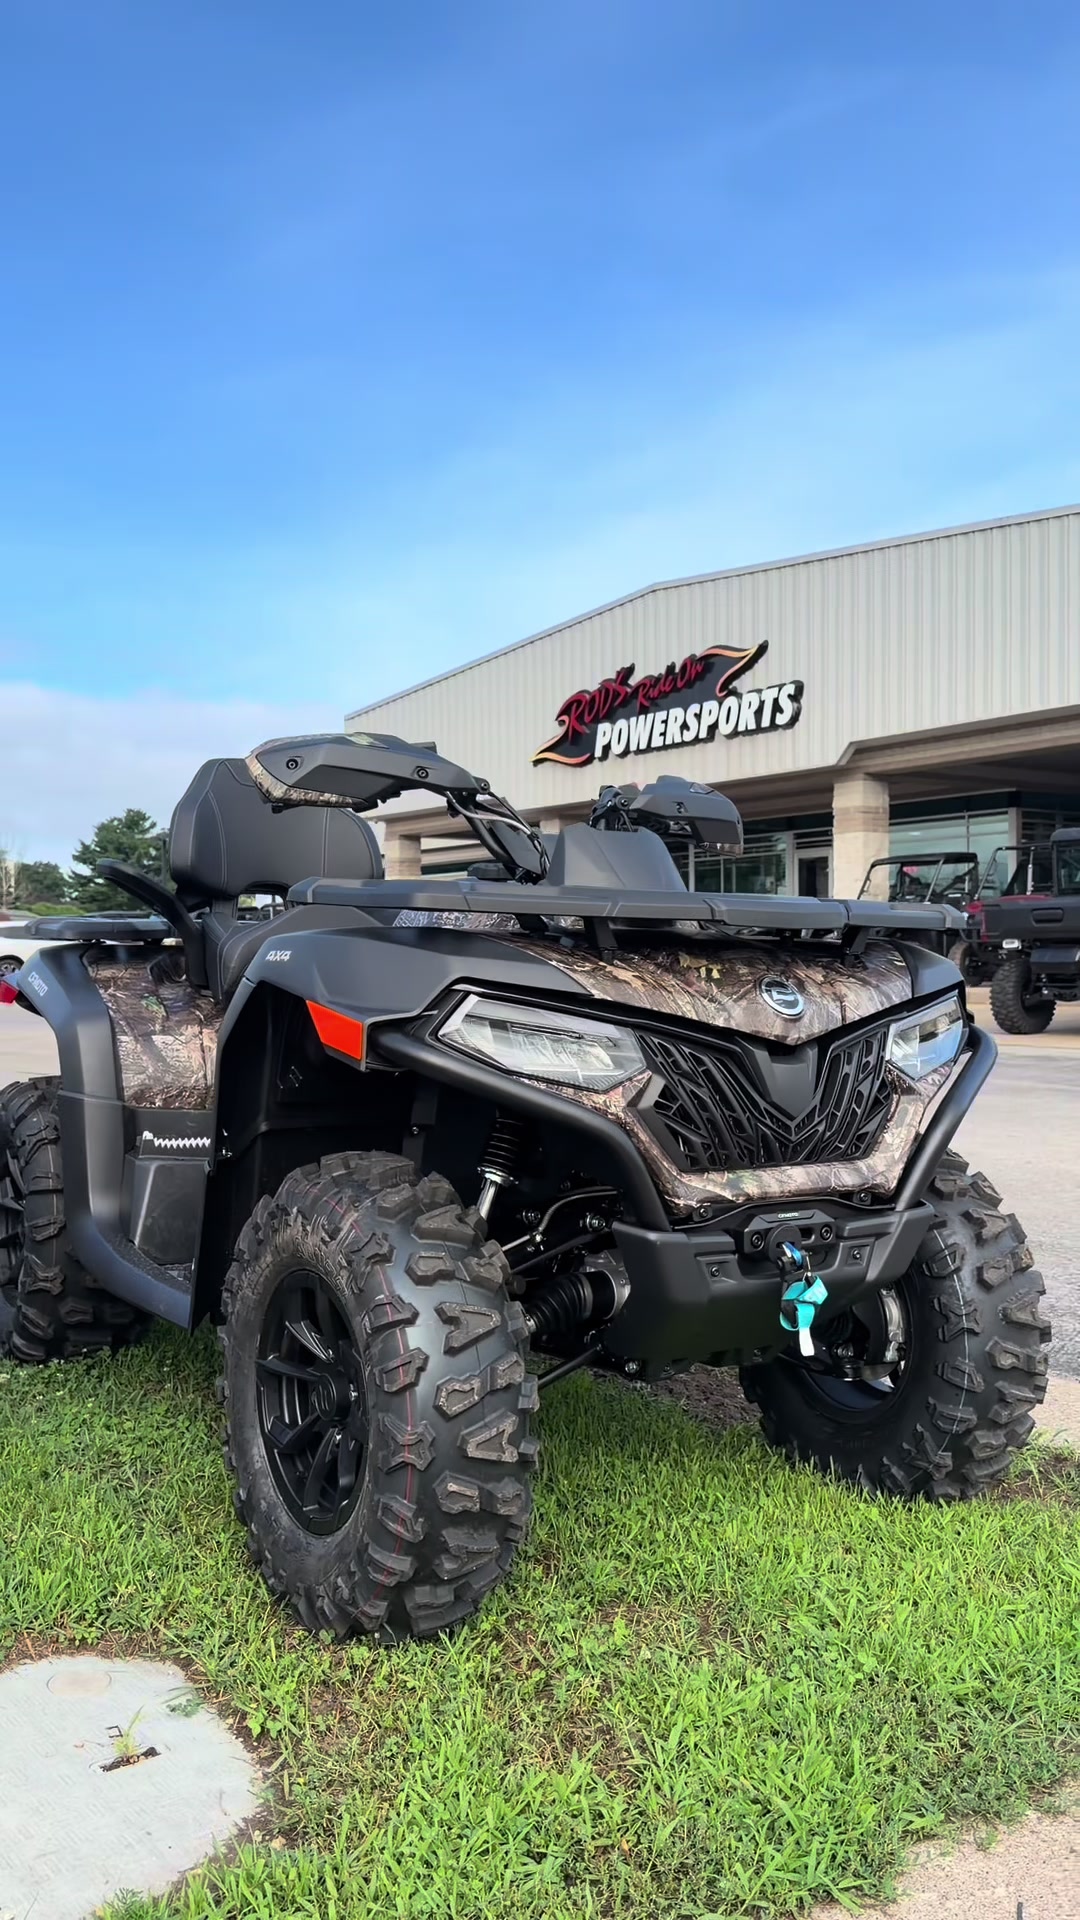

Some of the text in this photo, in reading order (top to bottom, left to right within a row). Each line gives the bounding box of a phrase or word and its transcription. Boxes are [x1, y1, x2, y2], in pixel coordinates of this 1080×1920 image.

[631, 666, 675, 711] Ride
[677, 657, 705, 688] On
[594, 683, 796, 758] POWERSPORTS
[265, 950, 292, 961] 4X4
